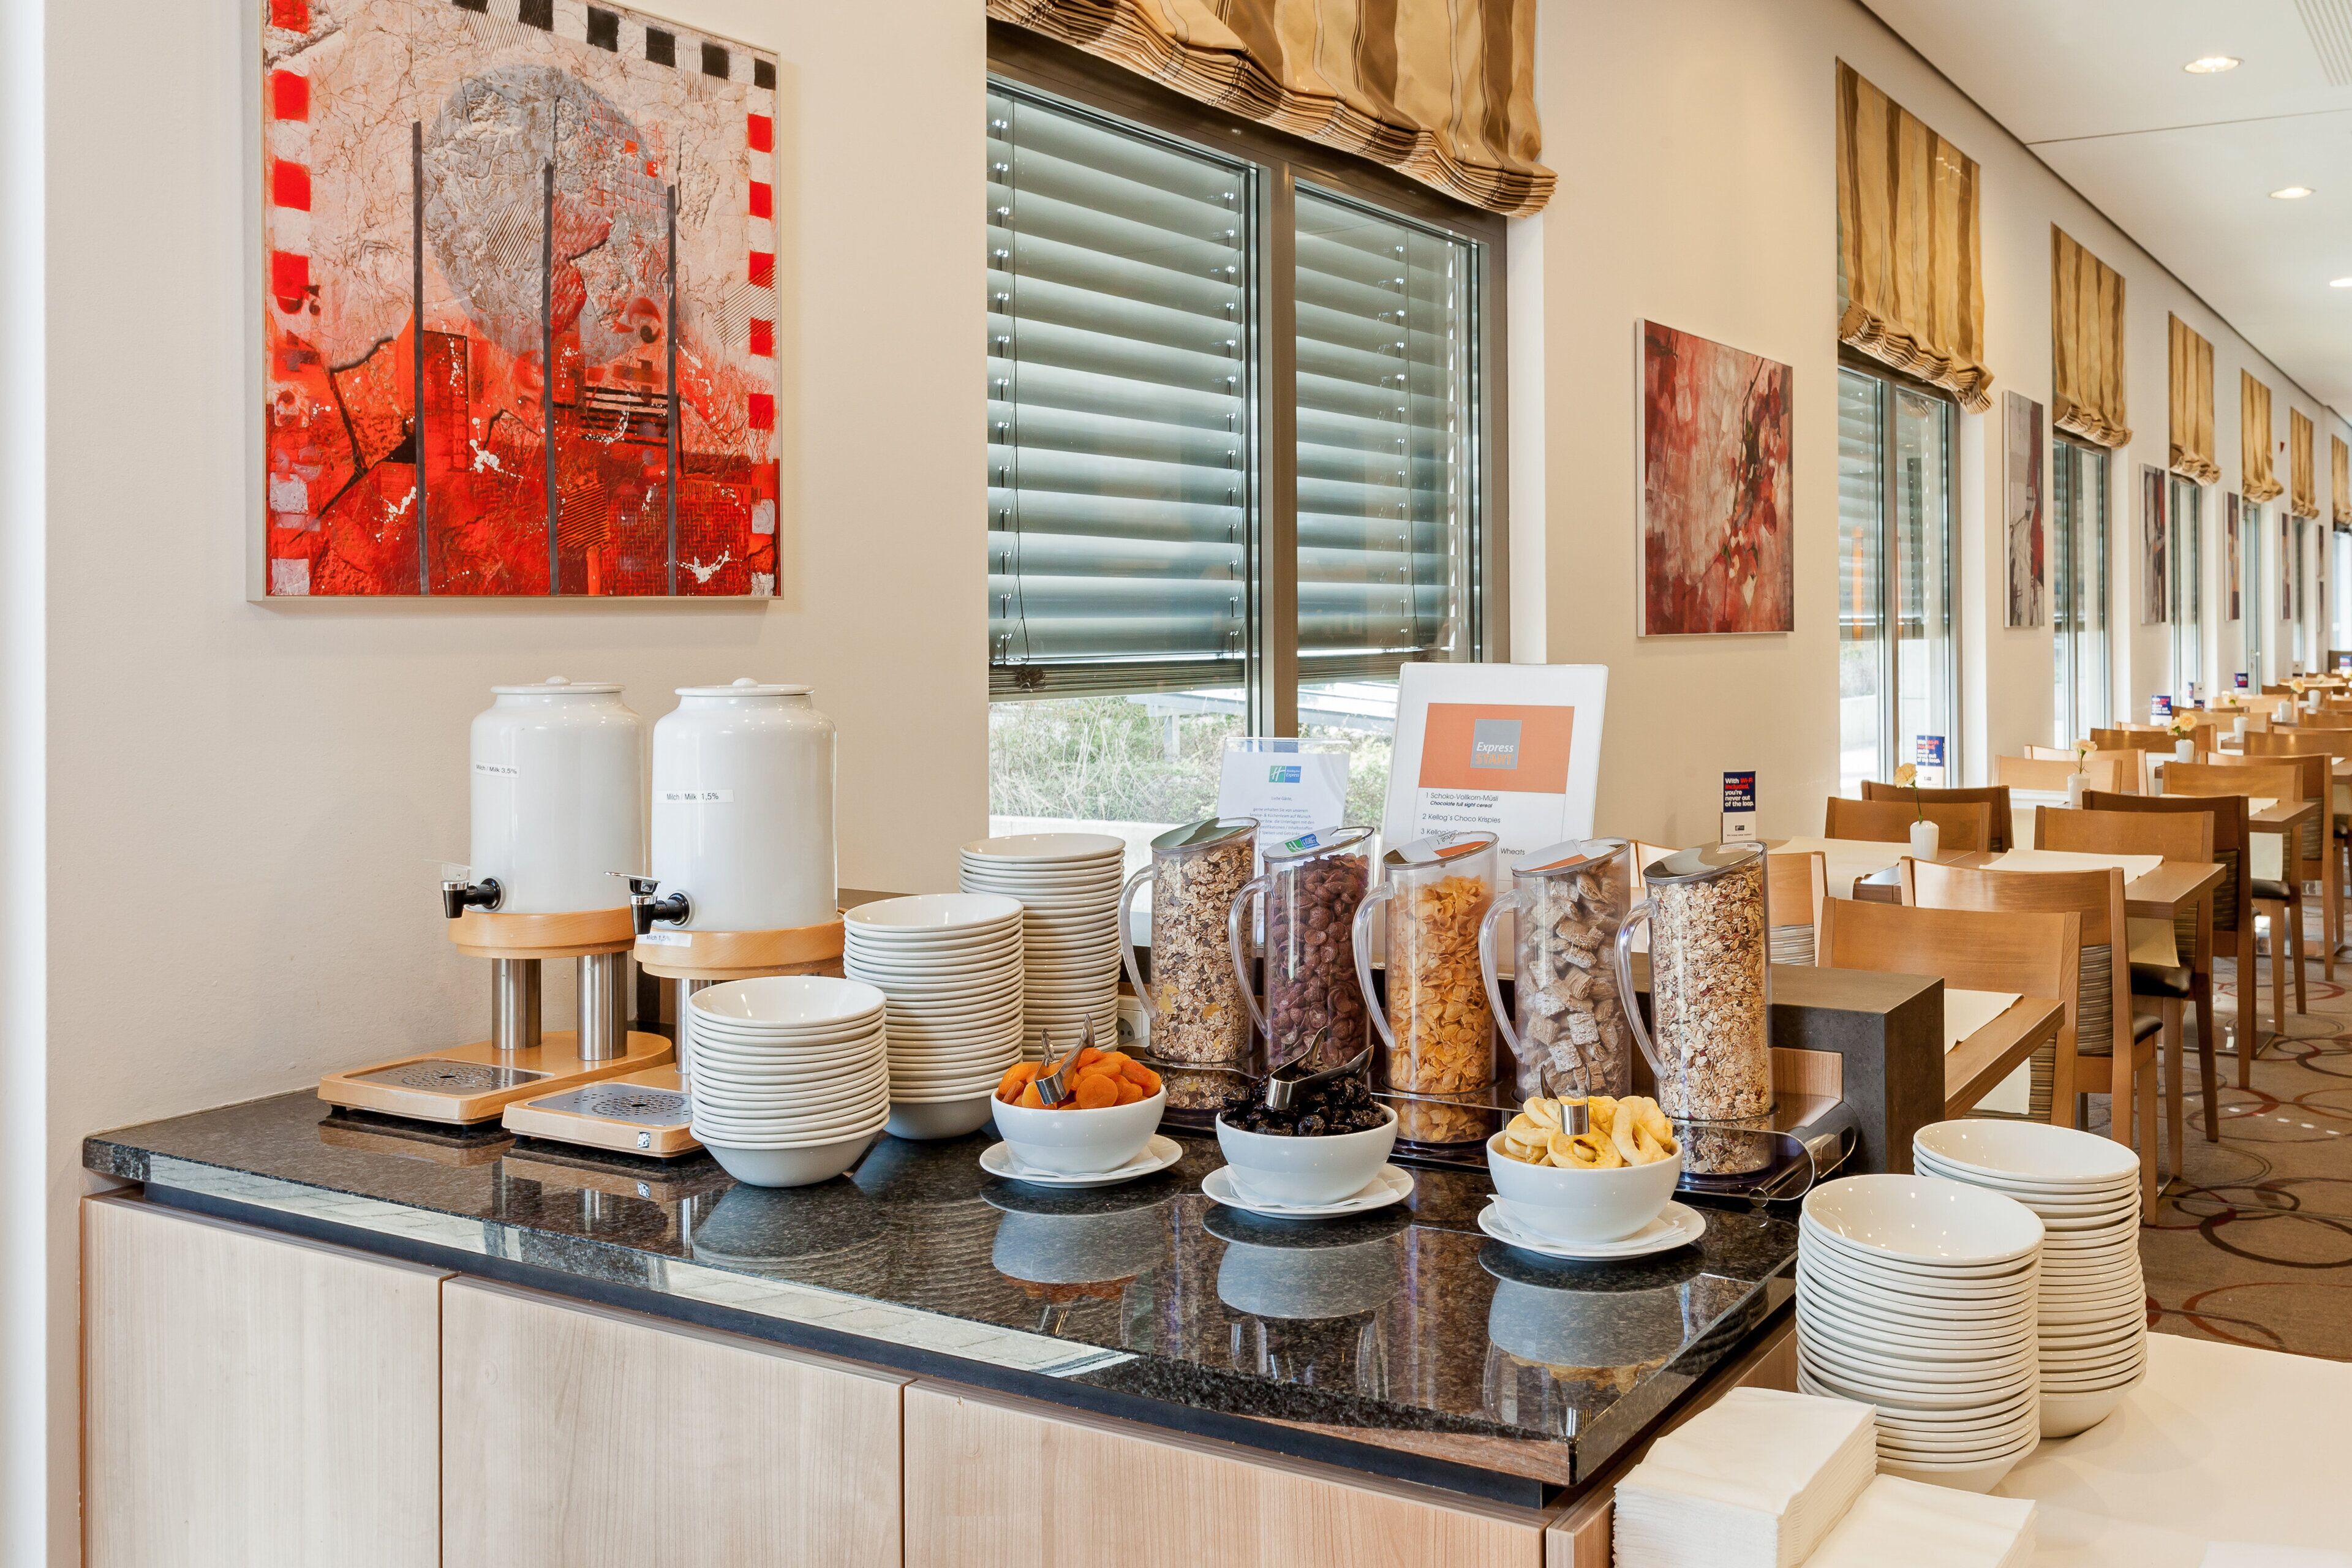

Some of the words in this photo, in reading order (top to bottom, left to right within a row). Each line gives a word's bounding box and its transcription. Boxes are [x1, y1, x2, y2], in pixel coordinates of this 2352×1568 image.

[1477, 742, 1514, 754] Express
[1476, 753, 1512, 765] START
[1478, 816, 1501, 824] Krispies
